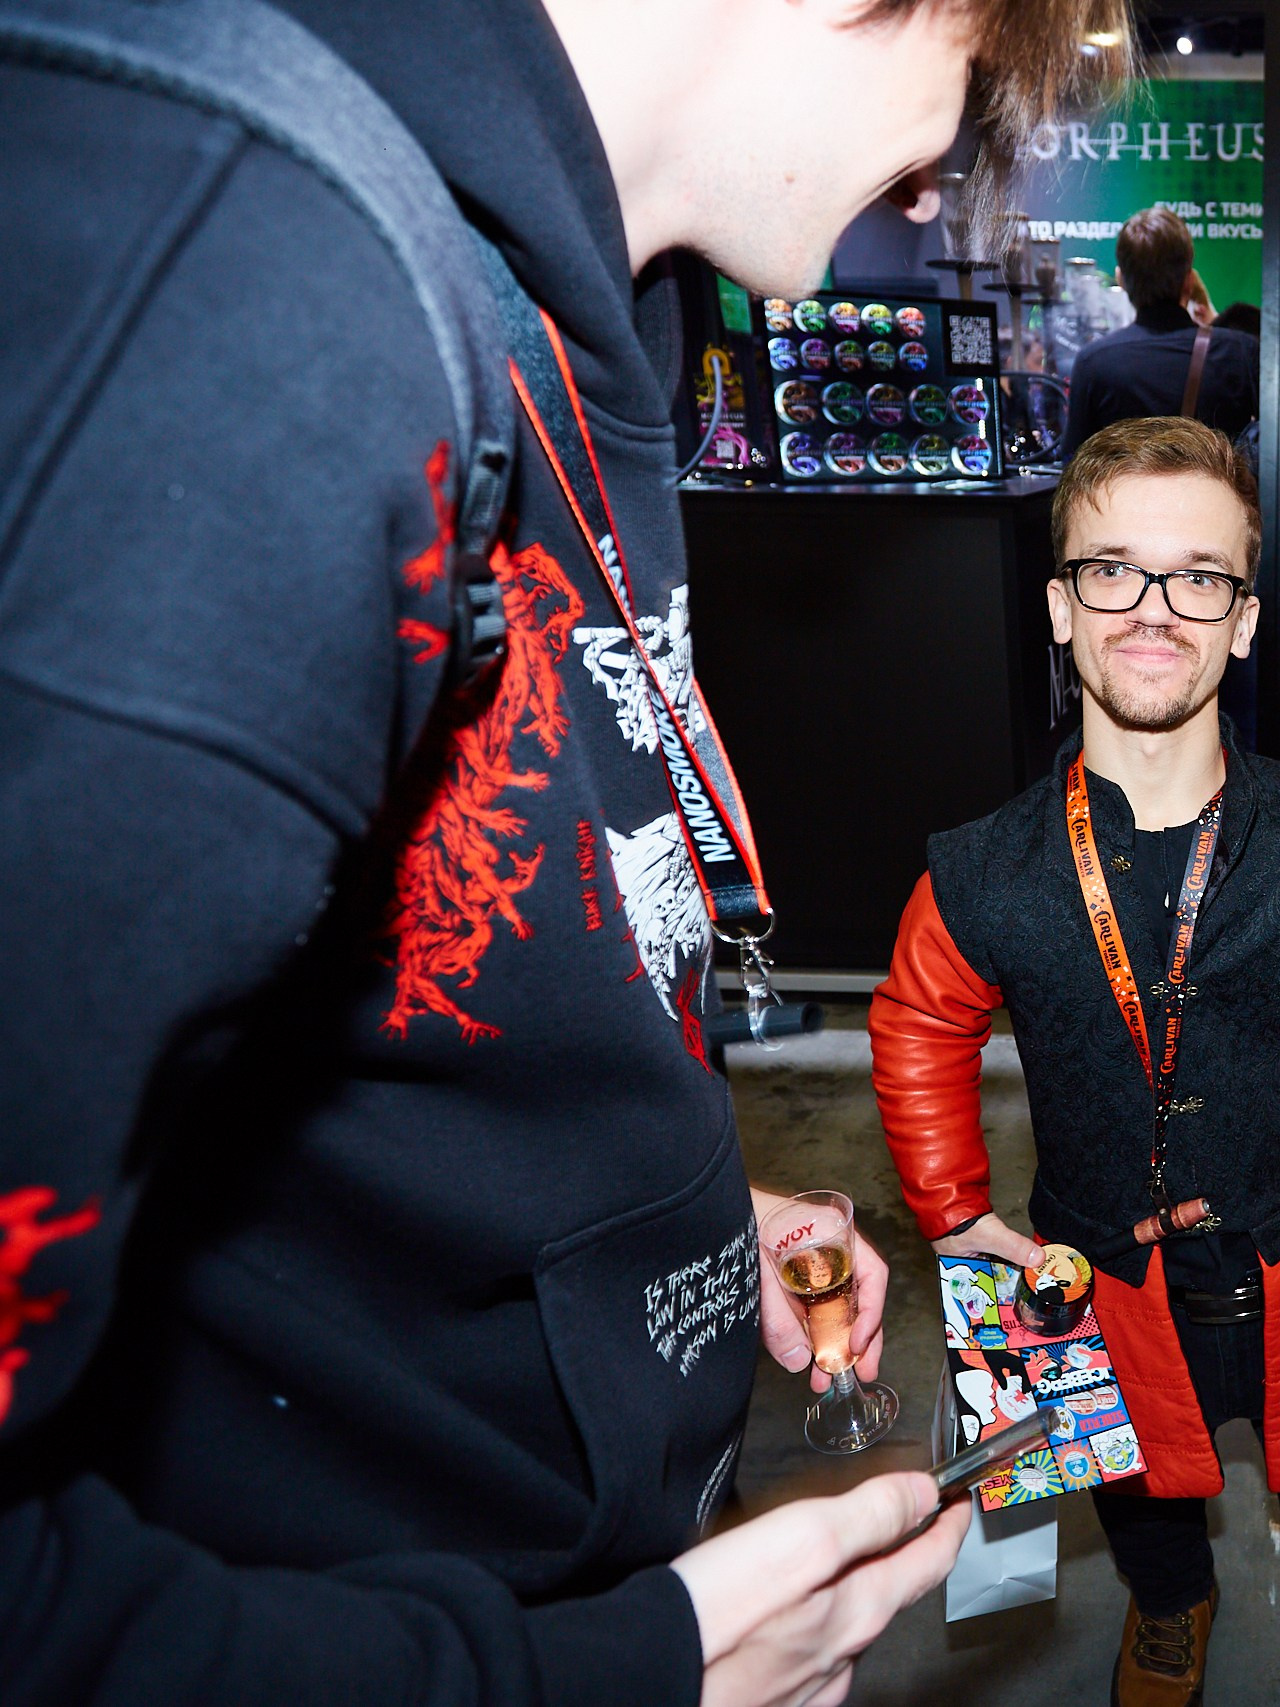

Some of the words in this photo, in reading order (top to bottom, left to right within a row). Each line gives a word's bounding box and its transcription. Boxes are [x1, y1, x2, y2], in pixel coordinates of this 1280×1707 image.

[1014, 122, 1264, 161] ORPHEUS
[1071, 818, 1095, 876] CARLIVAN
[1186, 831, 1211, 890] CARLIVAN
[1093, 910, 1121, 970] CARLIVAN
[1102, 949, 1112, 971] TOBACCO
[1167, 924, 1190, 984] CARLIVAN
[1160, 1017, 1177, 1074] CARLIVAN
[1036, 1367, 1111, 1394] ICEBERG
[984, 1474, 1012, 1490] YES
